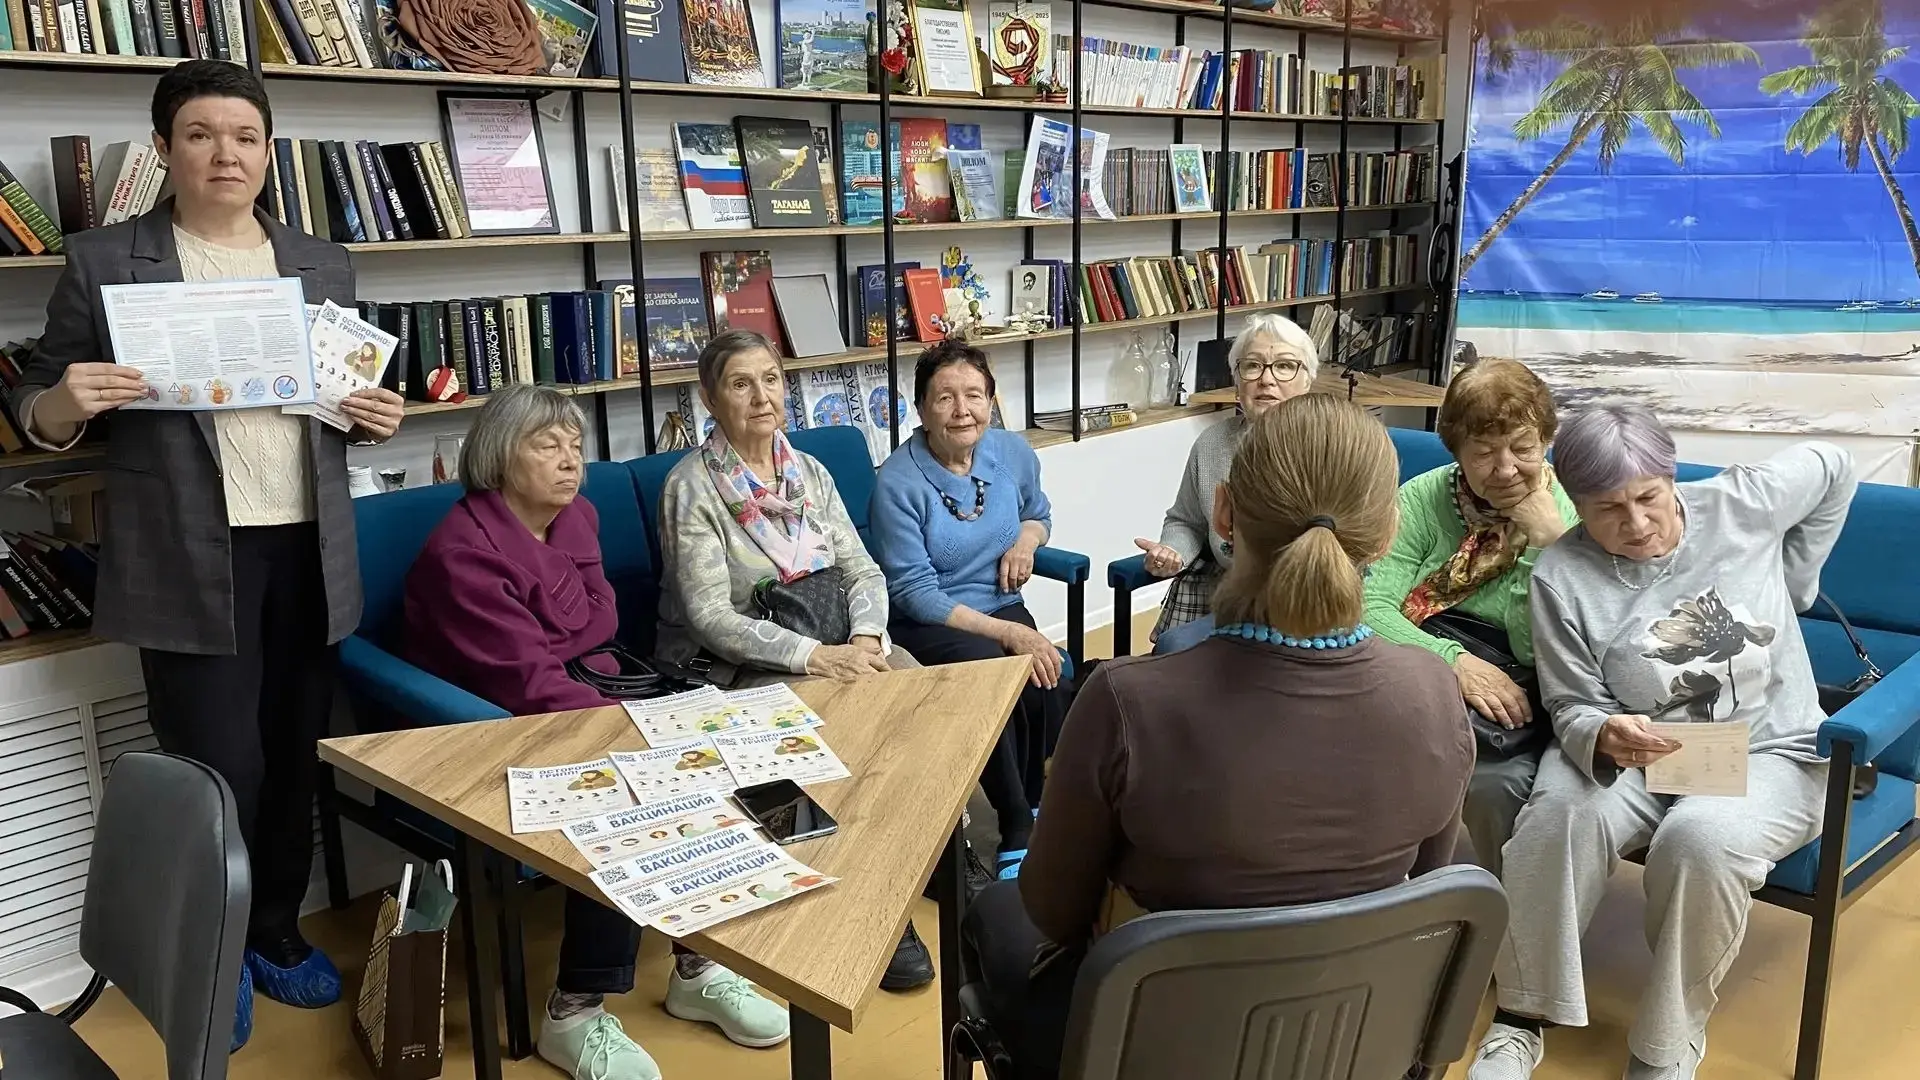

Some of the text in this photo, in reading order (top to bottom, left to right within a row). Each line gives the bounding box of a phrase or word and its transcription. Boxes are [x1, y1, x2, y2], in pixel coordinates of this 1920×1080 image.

[960, 156, 986, 167] ДИПЛОМ
[771, 198, 811, 210] ТАГАНАЙ
[655, 297, 700, 306] СЕВЕРО-ЗАПАДА
[489, 325, 502, 371] ФАРАОН
[811, 368, 844, 384] АТЛА
[864, 362, 889, 377] АТЛА
[843, 367, 863, 423] АТЛАС
[606, 800, 673, 821] ПРОФИЛАКТИКА
[671, 793, 701, 806] ГРИППА
[609, 796, 716, 829] ВАКЦИНАЦИЯ
[635, 829, 734, 865] ПРОФИЛАКТИКА ГРИППА
[640, 832, 750, 875] ВАКЦИНАЦИЯ
[665, 849, 763, 887] ПРОФИЛАКТИКА ГРИППА
[669, 852, 780, 896] ВАКЦИНАЦИЯ
